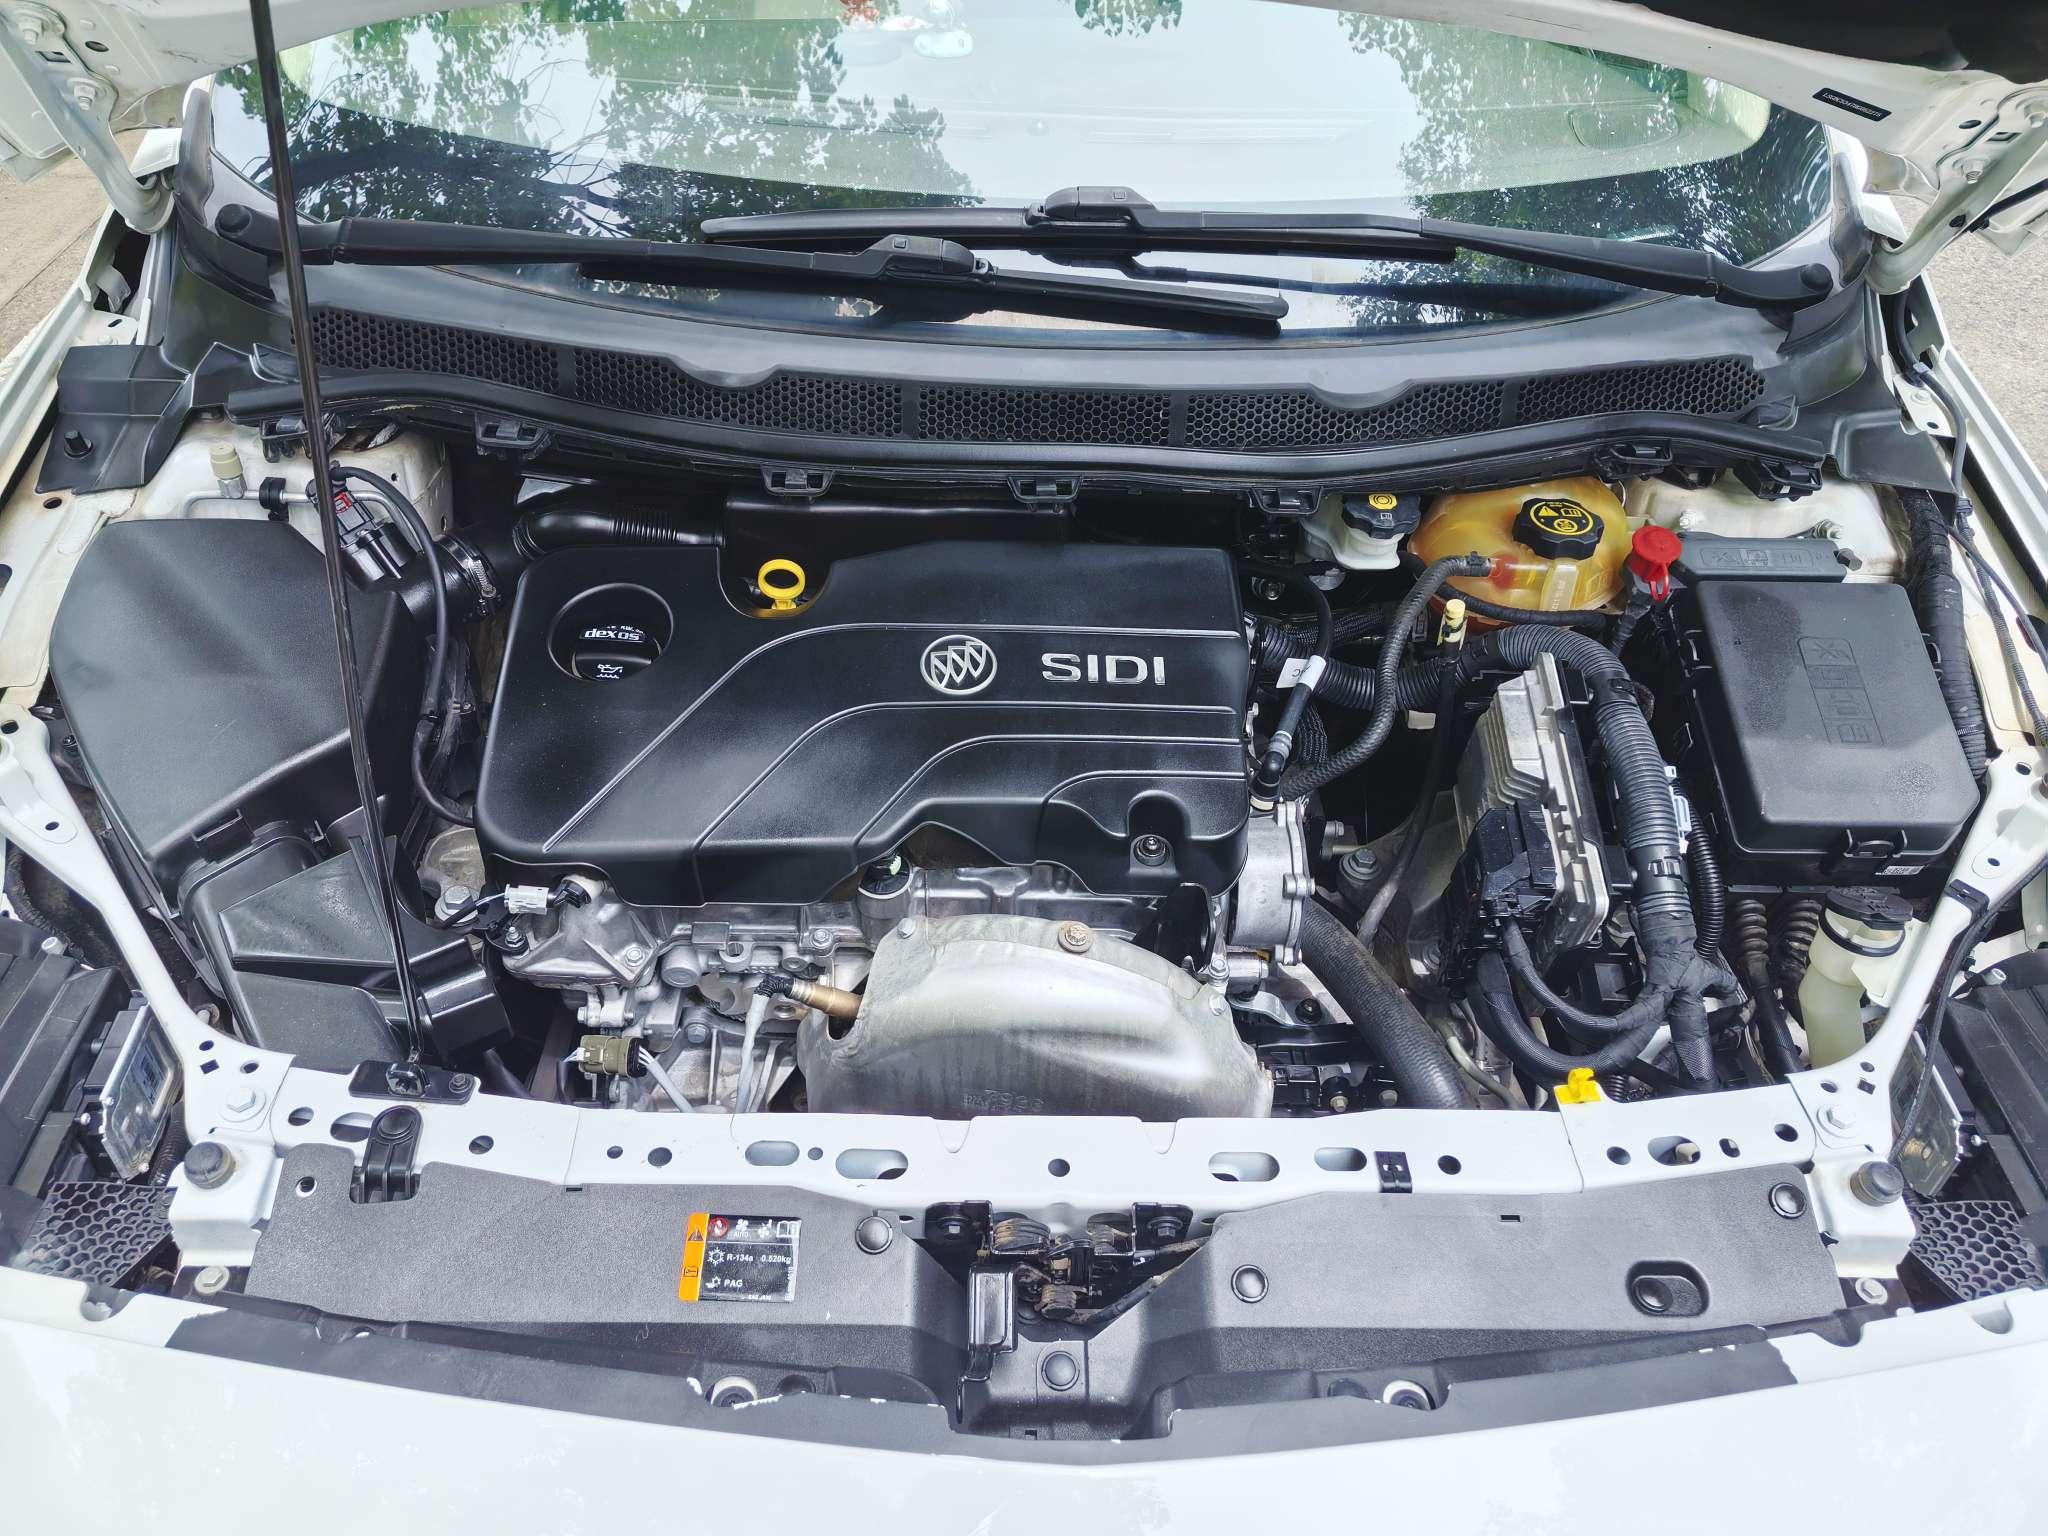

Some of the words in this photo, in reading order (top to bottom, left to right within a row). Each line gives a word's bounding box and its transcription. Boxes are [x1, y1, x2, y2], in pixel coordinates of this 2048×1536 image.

[584, 628, 640, 641] dexos
[1041, 653, 1166, 685] SIDI
[726, 1253, 754, 1262] R-134a
[761, 1254, 792, 1265] 0.520kg
[723, 1279, 743, 1288] PAG
